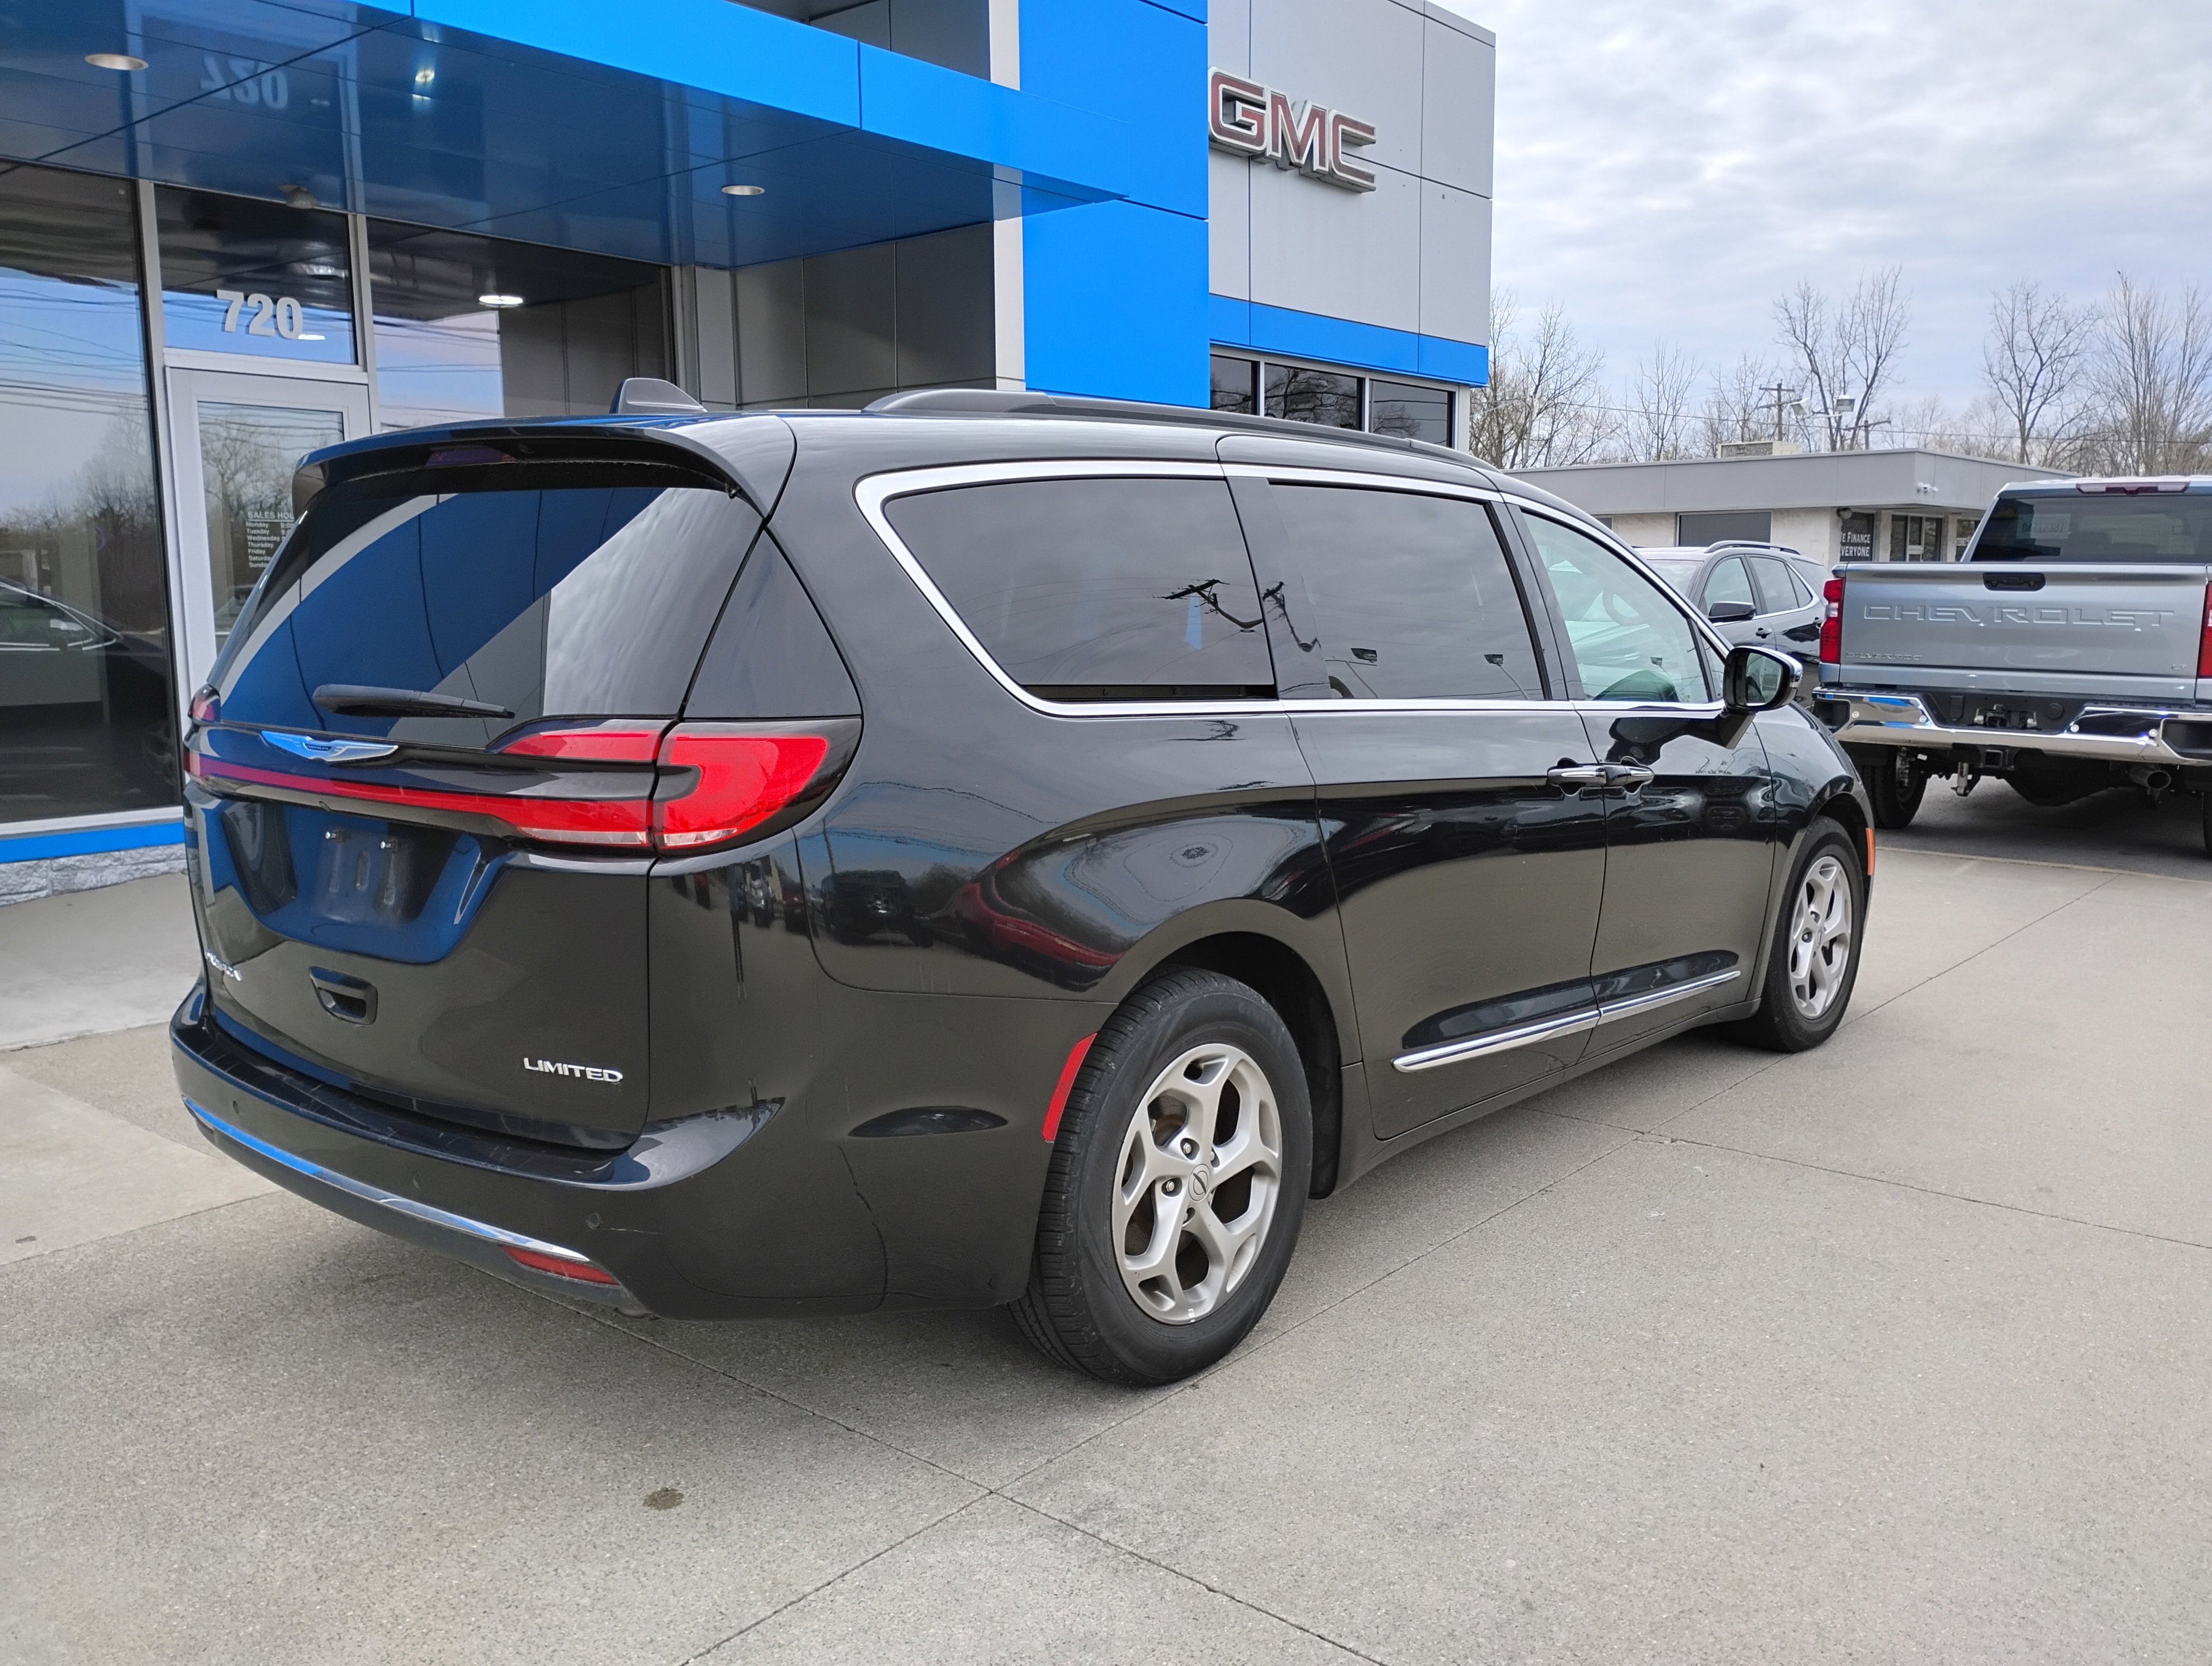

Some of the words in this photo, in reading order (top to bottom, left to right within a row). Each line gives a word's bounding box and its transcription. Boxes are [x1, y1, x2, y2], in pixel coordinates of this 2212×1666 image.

[1208, 66, 1377, 193] GMC
[217, 289, 304, 339] 720
[1847, 531, 1870, 543] FINANCE
[1840, 546, 1870, 556] VERYONE
[1864, 605, 2175, 626] CHEVROLET
[1846, 652, 1922, 661] SILVERADO
[523, 1058, 623, 1082] LIMITED
